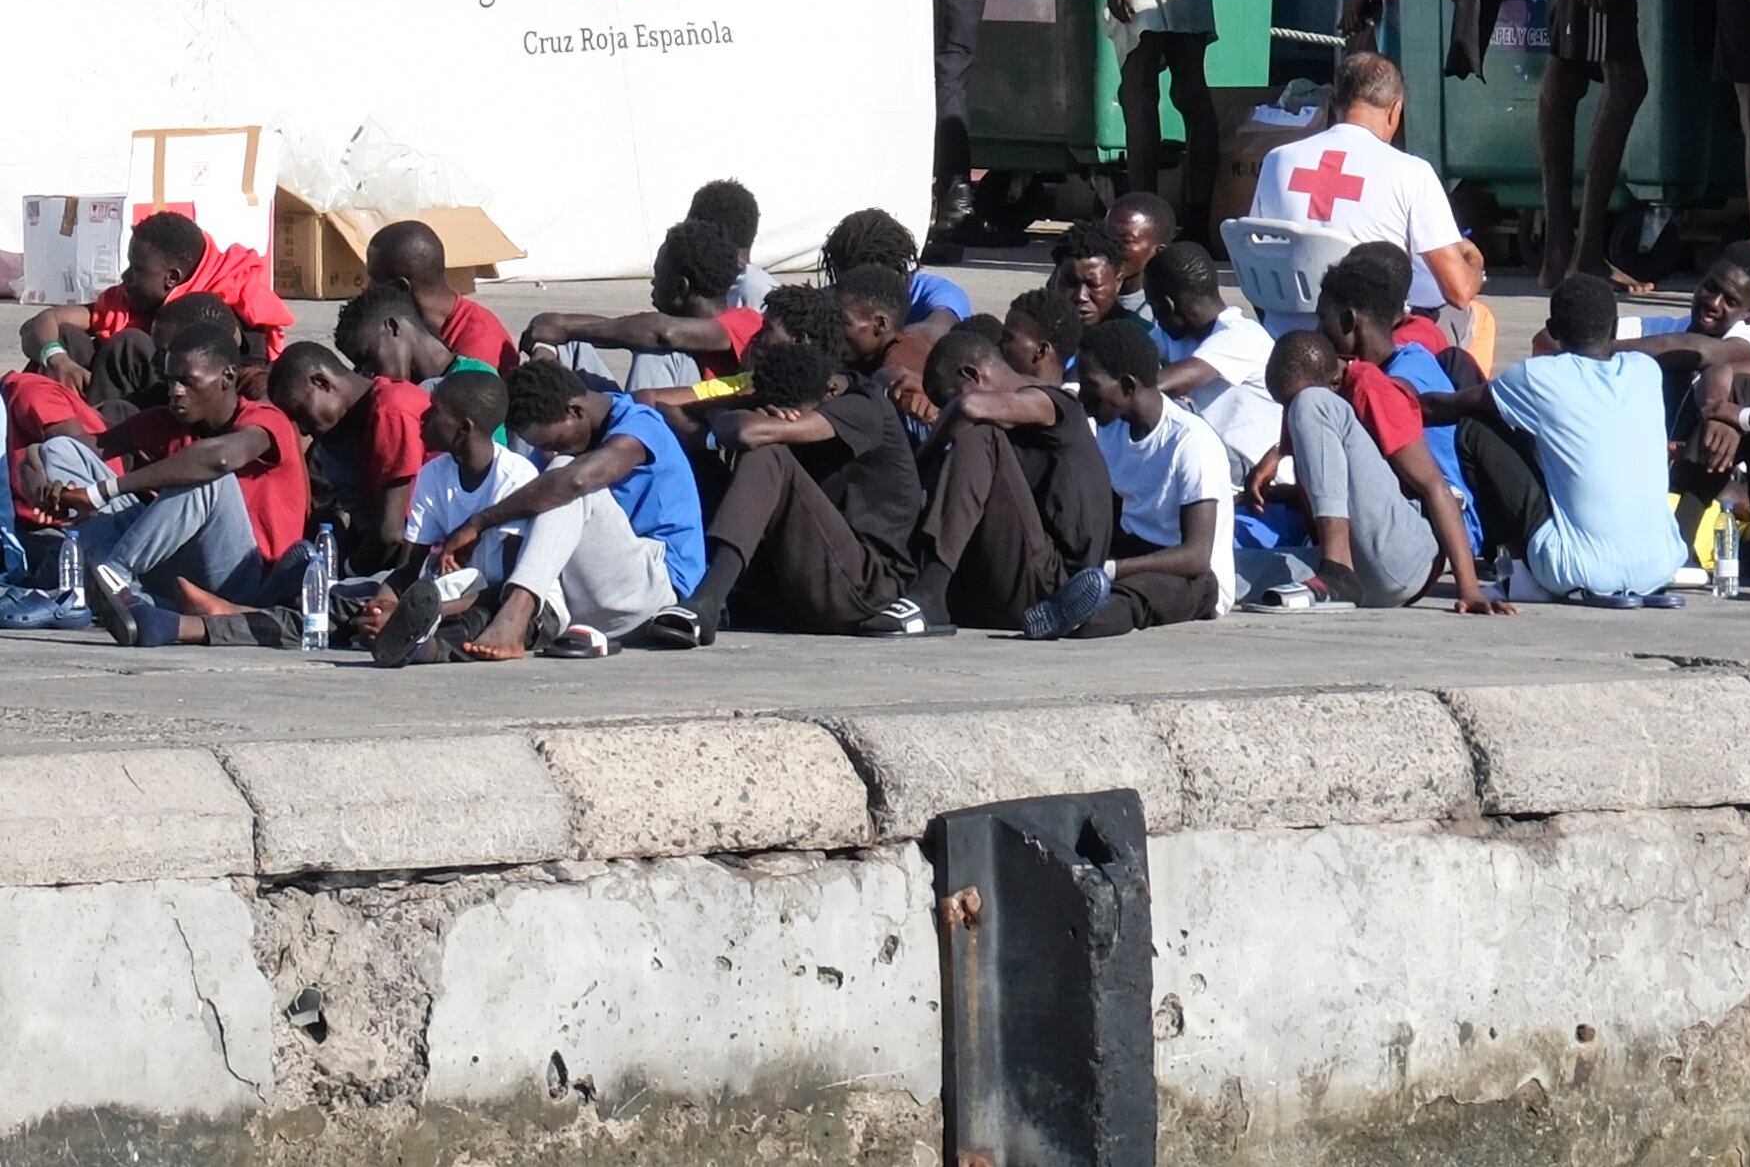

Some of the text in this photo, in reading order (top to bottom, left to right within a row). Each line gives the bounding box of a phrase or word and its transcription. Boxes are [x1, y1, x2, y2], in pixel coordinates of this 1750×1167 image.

[523, 20, 735, 57] Cruz Roja Española
[1489, 27, 1516, 46] APEL
